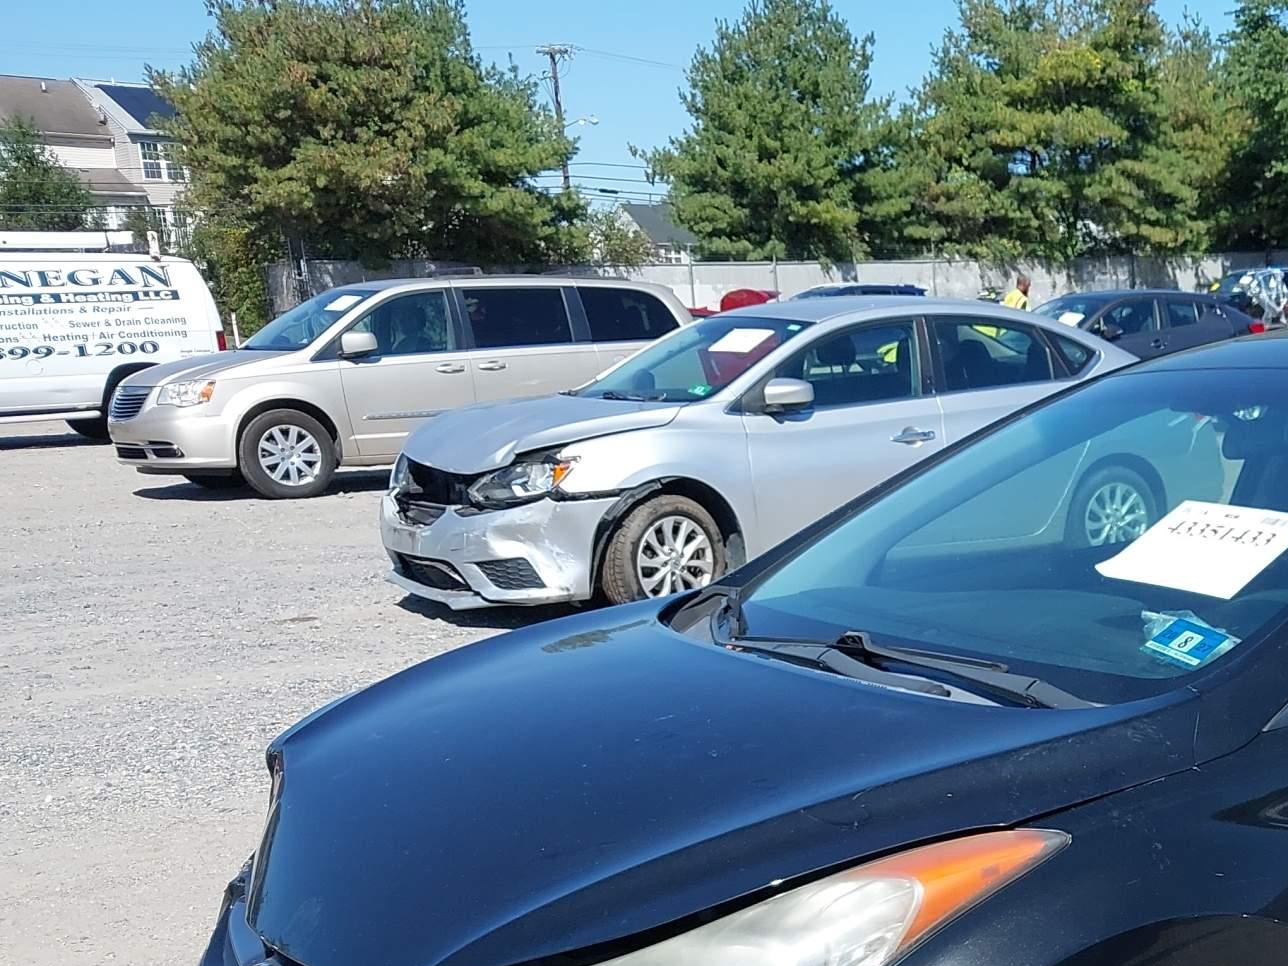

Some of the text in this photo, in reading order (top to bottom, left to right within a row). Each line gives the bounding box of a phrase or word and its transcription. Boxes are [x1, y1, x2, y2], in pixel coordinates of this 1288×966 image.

[0, 264, 172, 289] NEGAN
[40, 293, 55, 303] &
[60, 291, 134, 303] Heating
[139, 290, 173, 300] LLC
[79, 305, 87, 314] &
[92, 304, 132, 314] Repair
[0, 316, 187, 330] ruction Sewer & Drain Cleaning
[43, 332, 89, 342] Heating
[98, 331, 114, 340] Air
[118, 329, 188, 338] Conditioning
[1168, 520, 1277, 546] 43351433
[1177, 636, 1194, 648] 8
